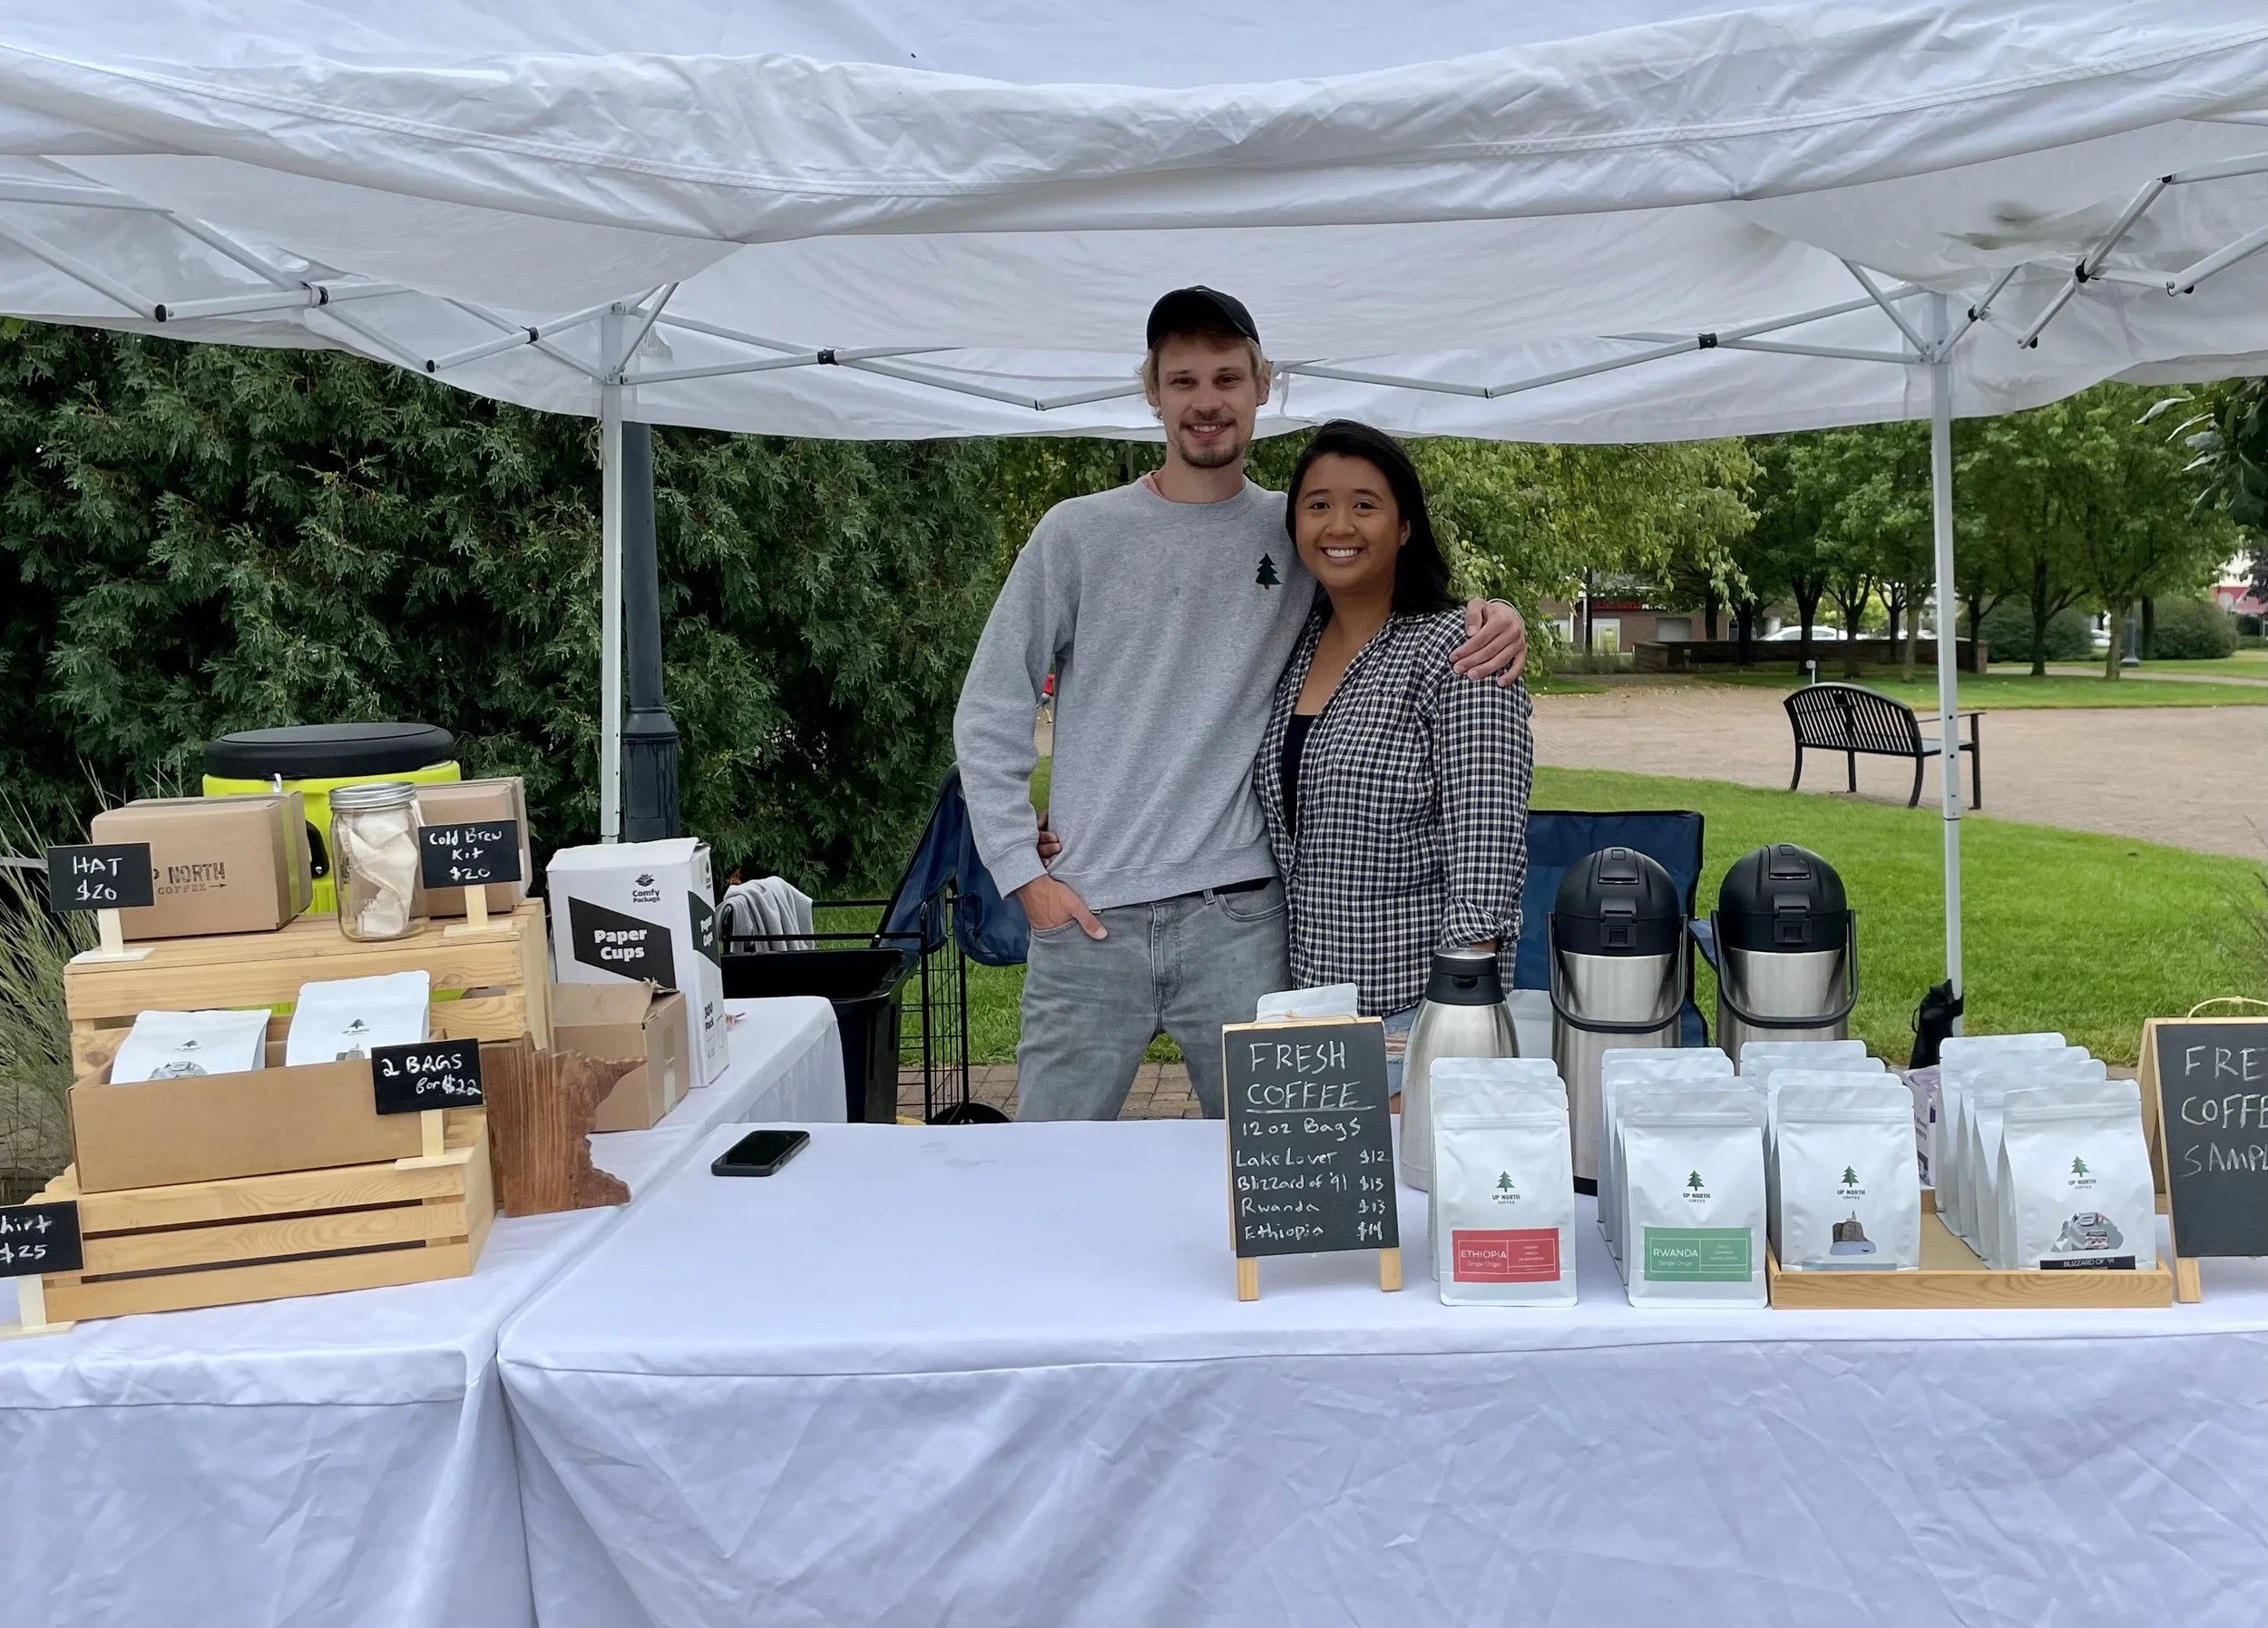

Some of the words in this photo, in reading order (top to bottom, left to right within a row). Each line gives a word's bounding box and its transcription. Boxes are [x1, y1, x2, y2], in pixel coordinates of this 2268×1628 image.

[429, 829, 459, 846] Cold
[465, 827, 503, 843] Brew
[452, 847, 484, 860] Kit
[73, 855, 122, 877] HAT
[168, 862, 226, 884] NORTH
[449, 866, 491, 882] $20
[75, 879, 118, 901] $20
[158, 883, 207, 896] COFFEE
[632, 889, 660, 897] Comfy
[593, 928, 648, 946] Paper
[600, 946, 645, 962] Cups
[381, 1058, 401, 1077] 2
[406, 1054, 463, 1074] BAGS
[1249, 1040, 1345, 1074] FRESH
[415, 1076, 441, 1094] for
[442, 1074, 482, 1096] $22
[1247, 1081, 1361, 1109] COFFEE
[1304, 1117, 1361, 1142] Bags
[1360, 1149, 1391, 1164] $12
[1237, 1174, 1305, 1192] Blizzard
[1308, 1174, 1323, 1189] of
[1359, 1175, 1384, 1192] $13
[1241, 1197, 1320, 1218] Rwanda
[1358, 1199, 1386, 1214] $13
[1245, 1222, 1324, 1241] Ethiopia
[1357, 1221, 1383, 1242] $14
[1461, 1250, 1507, 1259] ETHIOPIA
[1653, 1248, 1698, 1258] RWANDA
